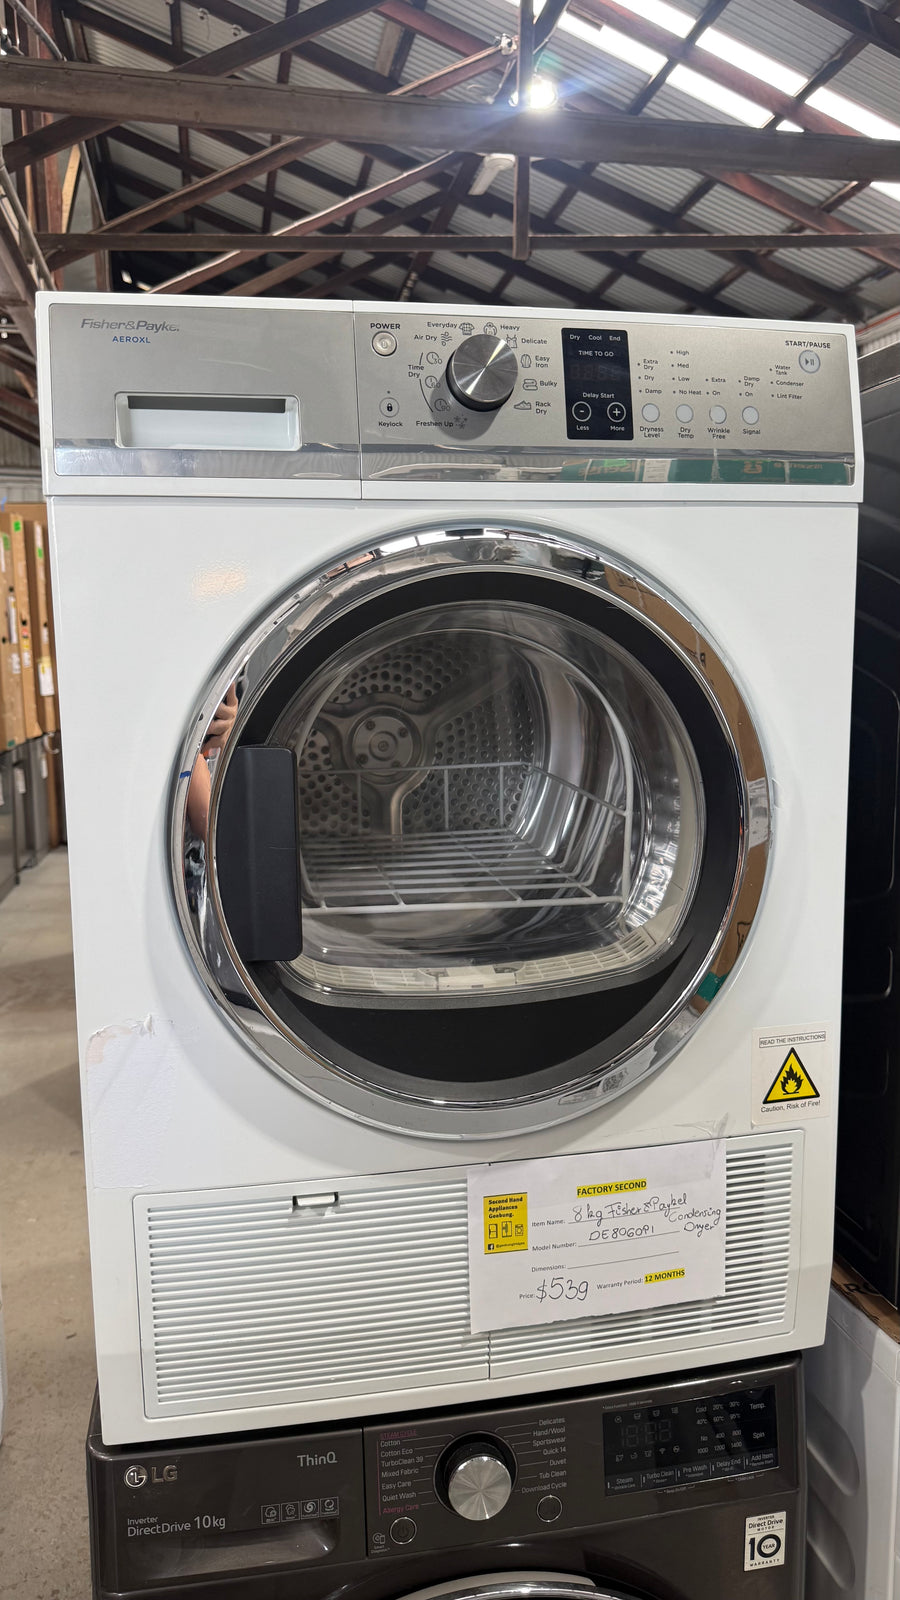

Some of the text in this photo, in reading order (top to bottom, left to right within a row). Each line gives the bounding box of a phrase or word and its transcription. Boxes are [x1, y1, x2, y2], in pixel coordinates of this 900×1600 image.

[80, 318, 180, 333] Fisher&Payke
[112, 336, 151, 344] AEROXL
[425, 334, 437, 342] Dry
[785, 340, 831, 348] START/PAUSE
[787, 1033, 825, 1043] INSTRUCTIONS
[761, 1105, 785, 1113] Caution,
[577, 1180, 647, 1197] FACTORY SECOND
[669, 1206, 721, 1224] Condensing
[684, 1222, 715, 1237] Dryer
[532, 1244, 549, 1252] Model
[551, 1241, 577, 1249] Number:
[532, 1264, 566, 1273] Dimensions:
[597, 1281, 622, 1291] Warranty
[623, 1278, 643, 1286] Period:
[654, 1270, 685, 1281] MONTHS
[536, 1277, 589, 1303] $539
[538, 1417, 565, 1426] Delicates
[533, 1426, 566, 1437] Hand/Wool
[753, 1432, 765, 1440] Spin
[380, 1440, 400, 1448] Cotton
[532, 1436, 566, 1448] Sportswear
[381, 1450, 401, 1458] Cotton
[697, 1447, 708, 1455] 1000
[297, 1451, 338, 1468] ThinQ
[381, 1458, 415, 1467] TurboClean
[550, 1458, 567, 1466] Duvet
[151, 1464, 178, 1483] LG
[382, 1470, 399, 1478] Mixed
[522, 1481, 567, 1493] Download Cycle
[128, 1516, 158, 1525] Inverter
[749, 1521, 766, 1529] Direct
[749, 1534, 781, 1560] 10
[750, 1559, 780, 1567] WARRANTY
